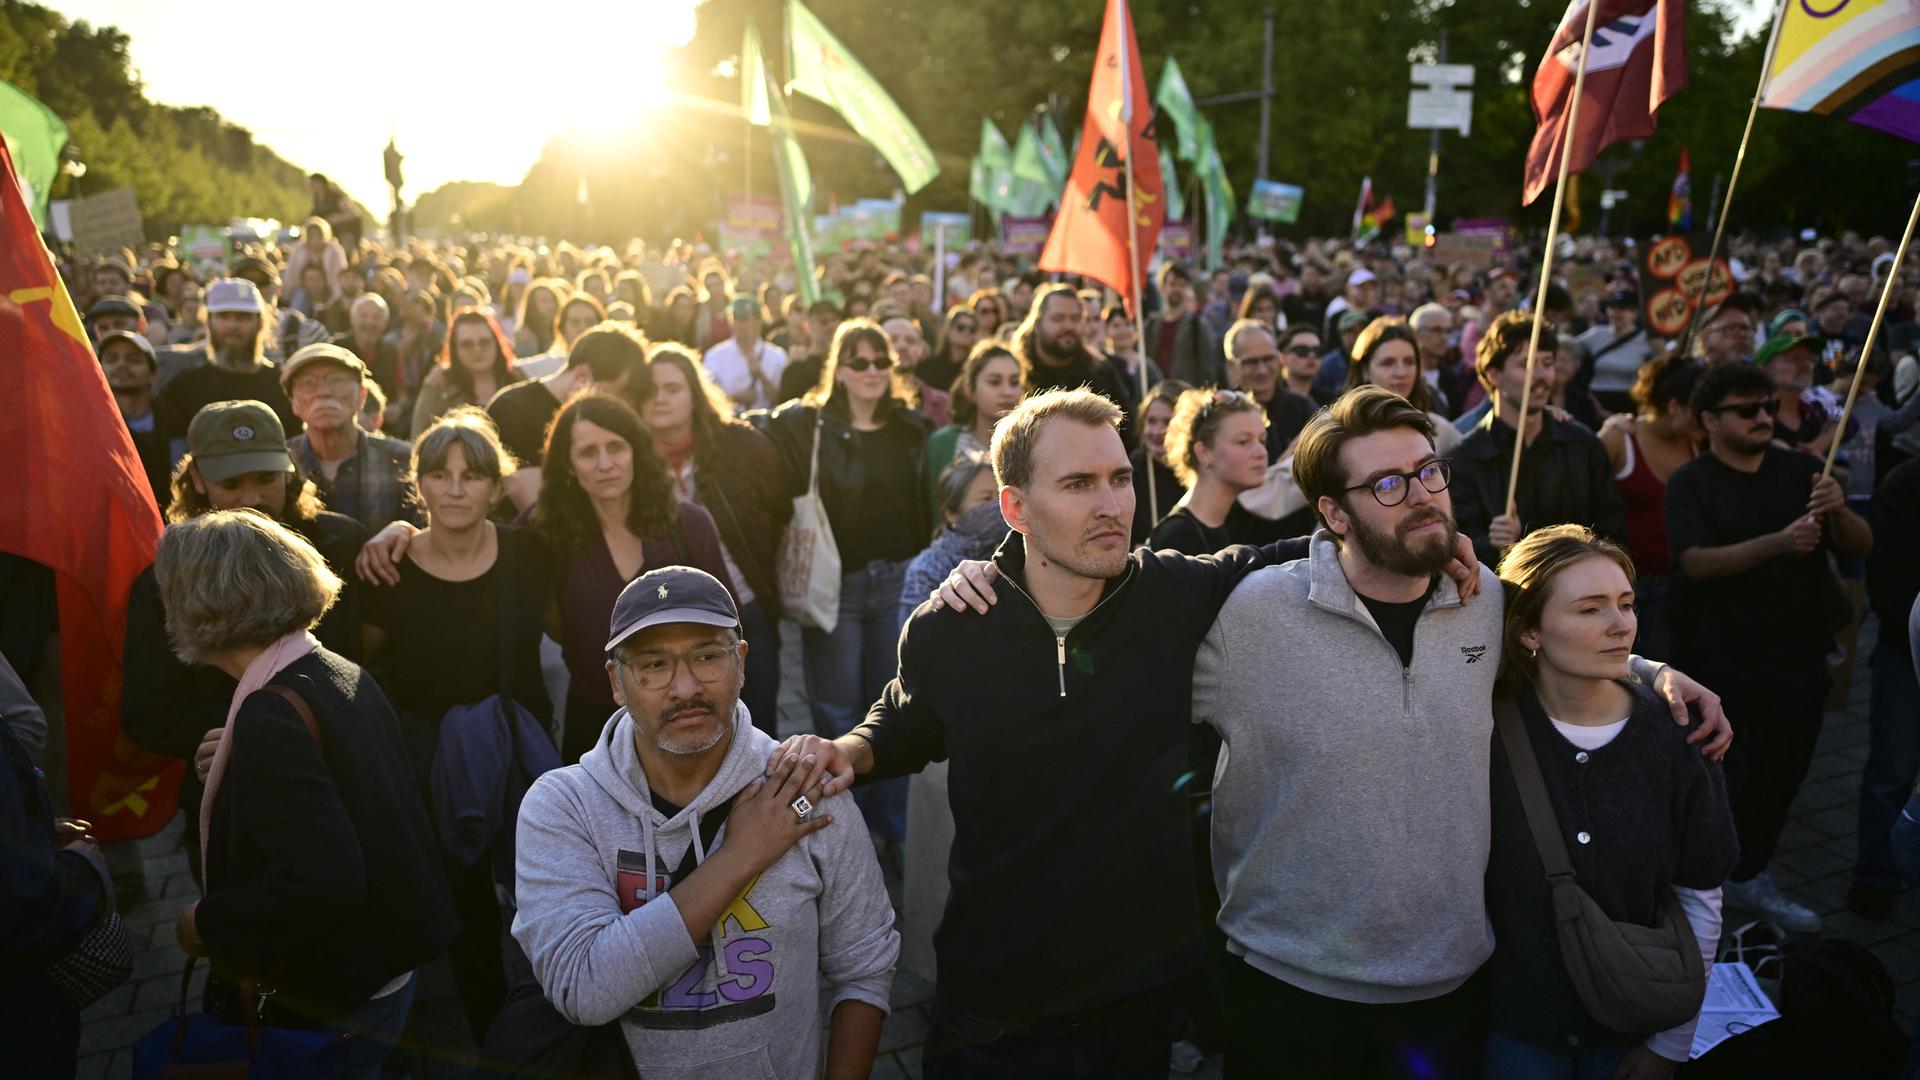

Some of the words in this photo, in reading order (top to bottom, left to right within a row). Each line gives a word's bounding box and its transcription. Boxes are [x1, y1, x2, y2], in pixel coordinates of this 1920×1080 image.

[1461, 645, 1486, 654] Reebok
[616, 870, 773, 938] FK
[638, 937, 775, 1008] ZS
